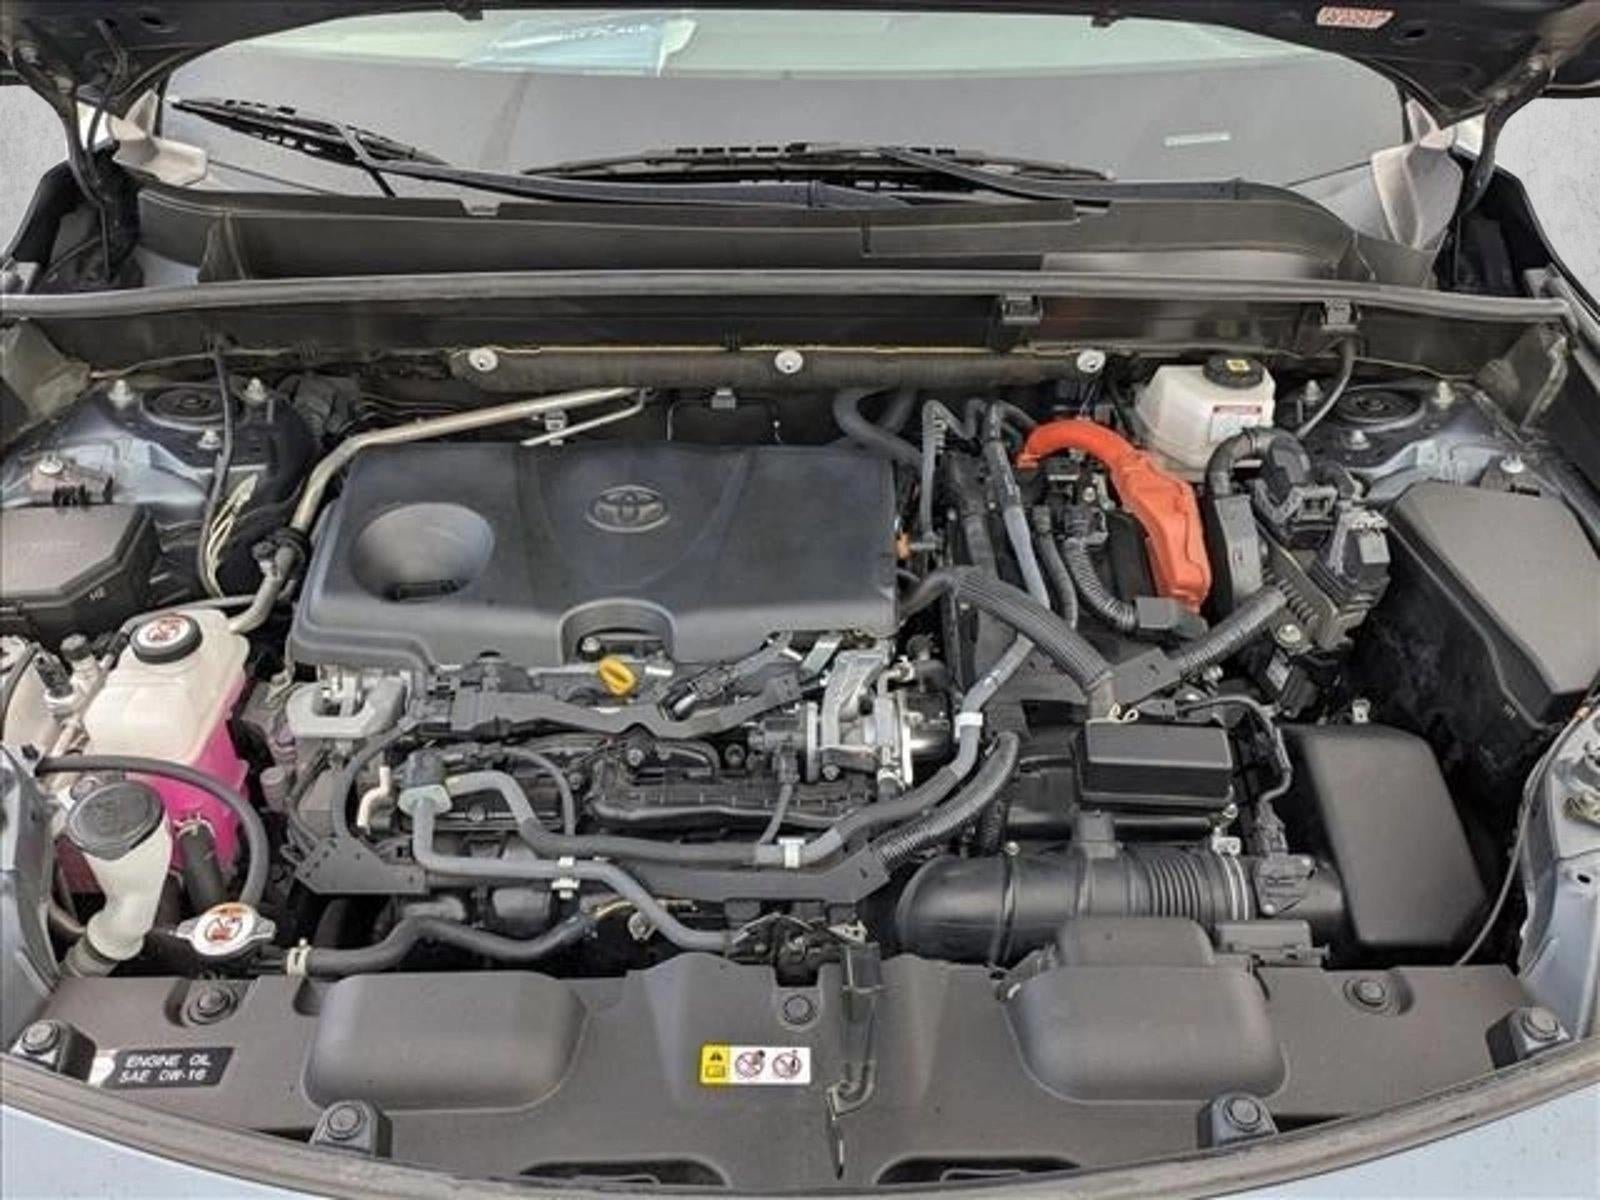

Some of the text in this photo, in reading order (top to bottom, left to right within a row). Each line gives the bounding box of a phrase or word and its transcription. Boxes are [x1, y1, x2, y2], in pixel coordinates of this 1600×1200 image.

[125, 1054, 211, 1068] ENGINE OIL
[119, 1069, 151, 1083] SAE
